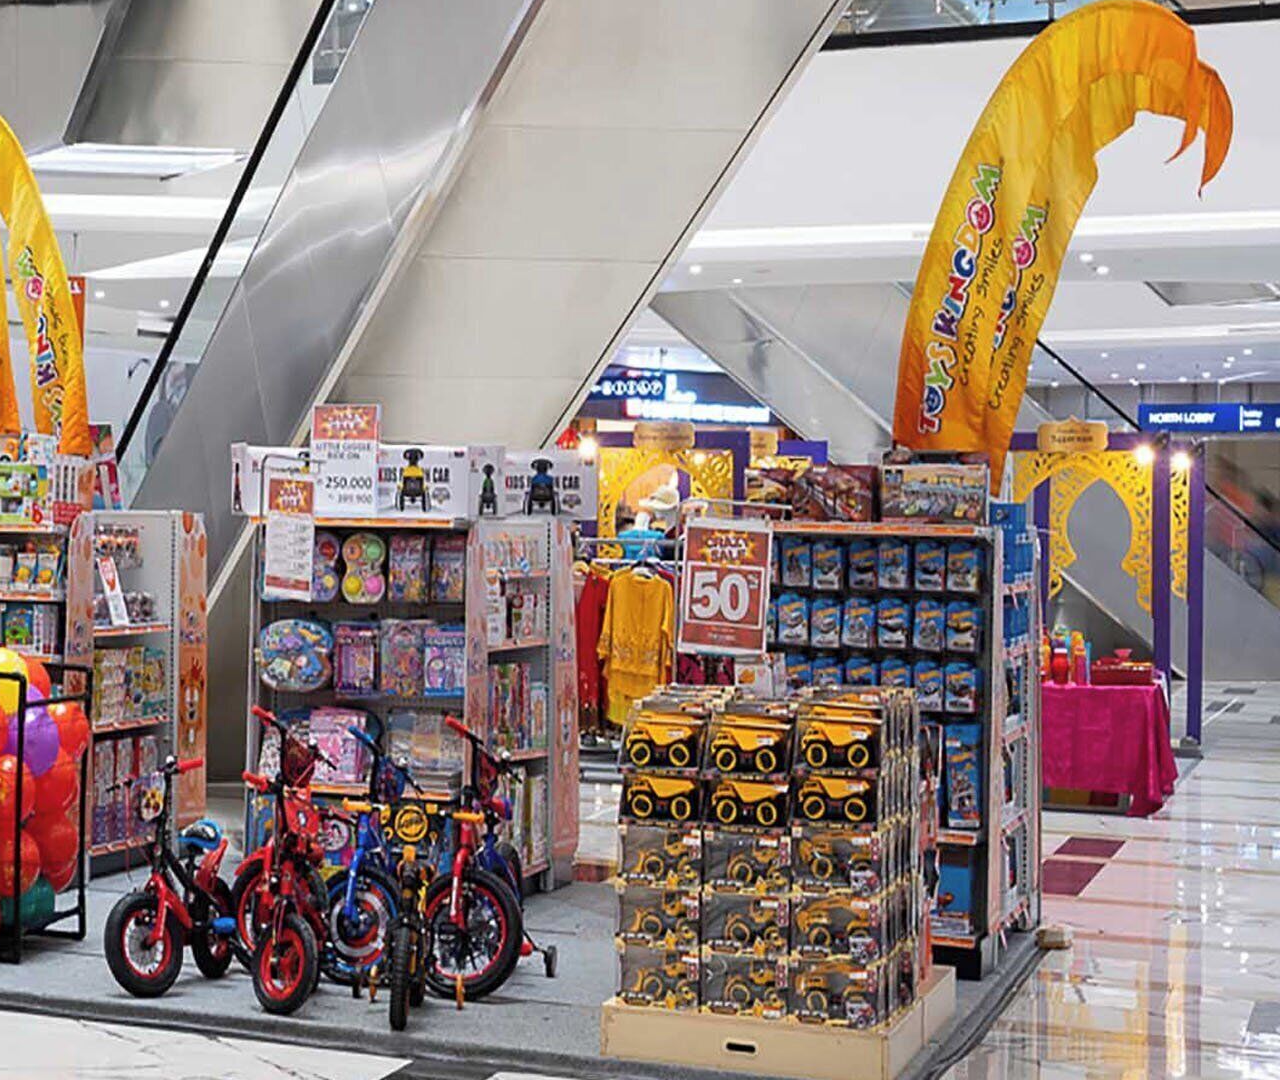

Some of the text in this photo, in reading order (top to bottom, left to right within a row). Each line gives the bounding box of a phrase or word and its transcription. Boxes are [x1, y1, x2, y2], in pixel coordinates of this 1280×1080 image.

[918, 162, 1003, 433] TOYS KINGDOM
[325, 476, 373, 490] 250.000
